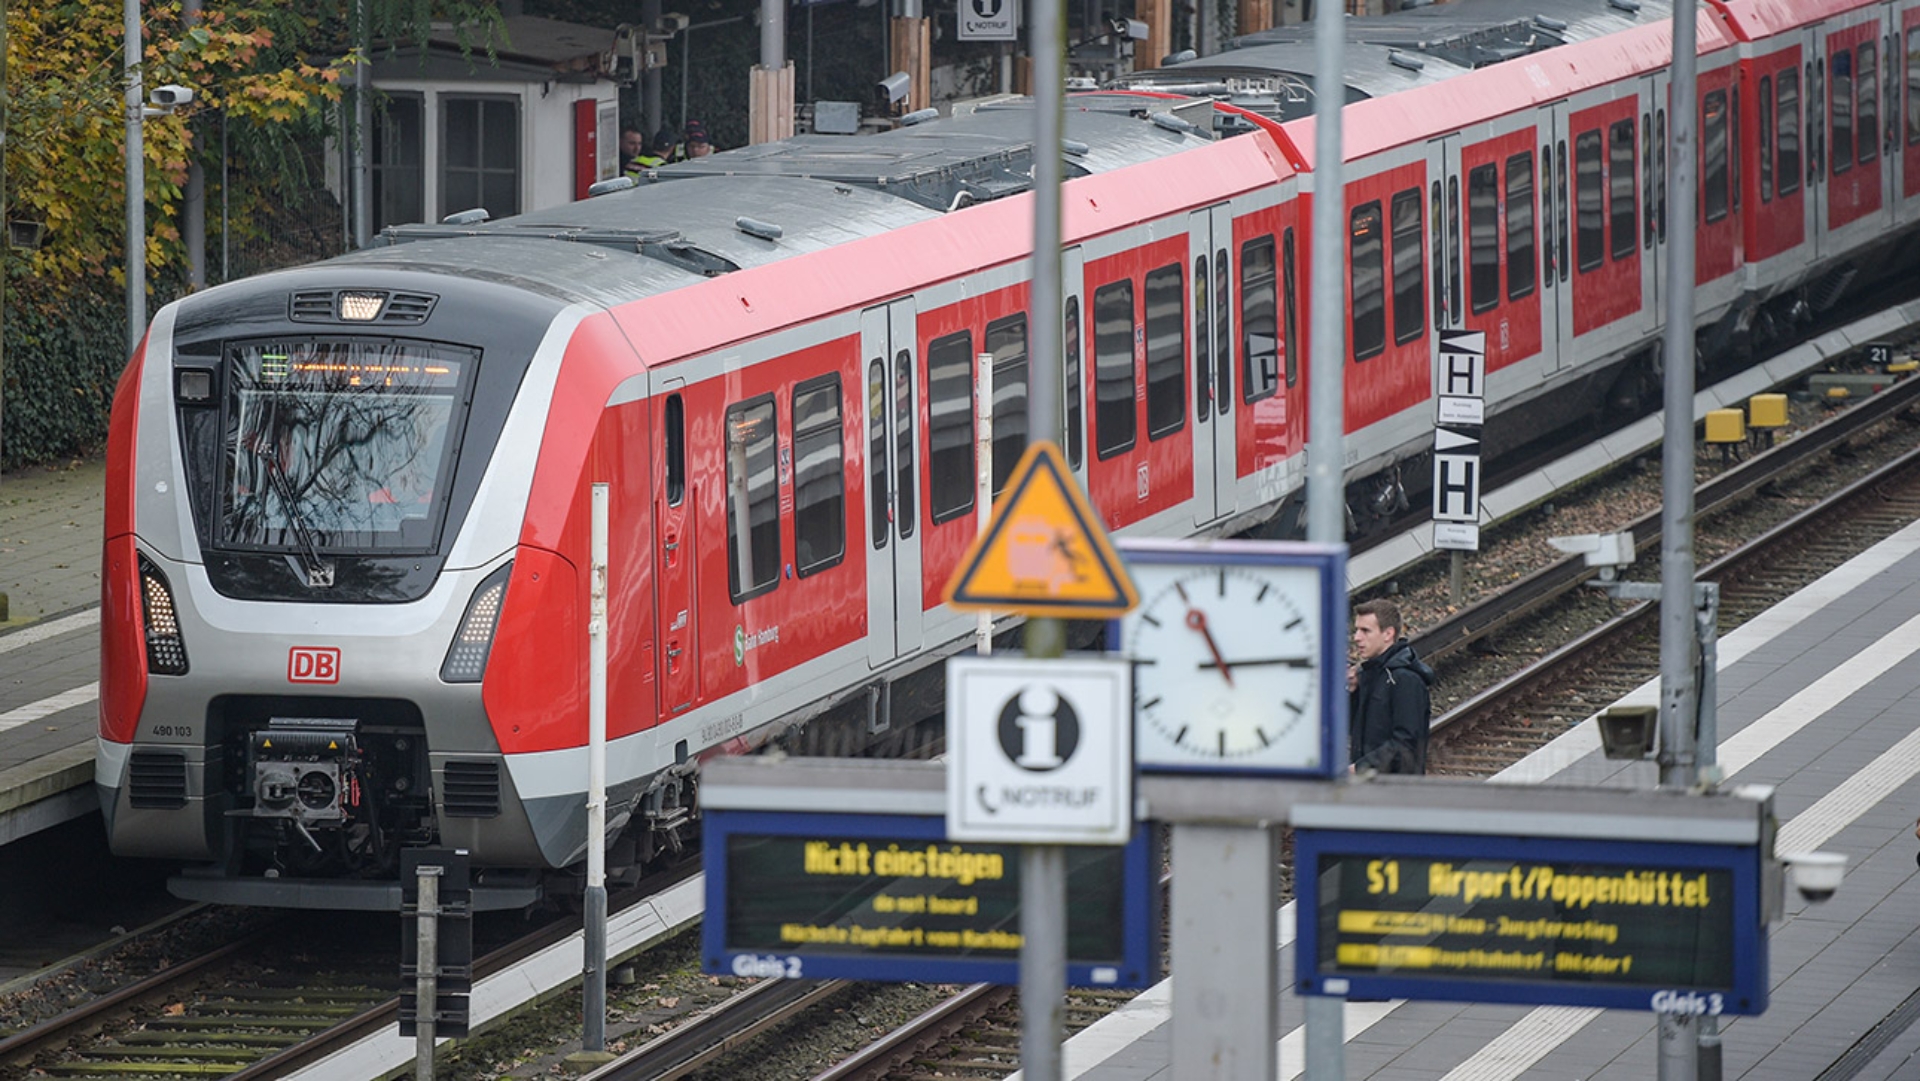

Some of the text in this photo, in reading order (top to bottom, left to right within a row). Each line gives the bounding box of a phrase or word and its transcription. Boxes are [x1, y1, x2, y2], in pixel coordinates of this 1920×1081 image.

[974, 21, 1008, 30] NOTRUF
[1871, 347, 1887, 361] 21
[1447, 355, 1475, 395] H
[1439, 460, 1474, 515] H
[294, 652, 335, 678] DB
[152, 725, 192, 737] 490 103
[1000, 785, 1099, 807] NOTRUF
[805, 841, 1004, 886] Nicht einsteigen
[1366, 859, 1710, 909] S1 Airport/Poppenbüttel
[873, 894, 979, 915] do not board
[1497, 915, 1619, 945] Jungfernstieg
[731, 953, 803, 979] Gleis 2
[1555, 951, 1633, 975] Ohlsdorf
[1651, 989, 1724, 1016] Gleis 3
